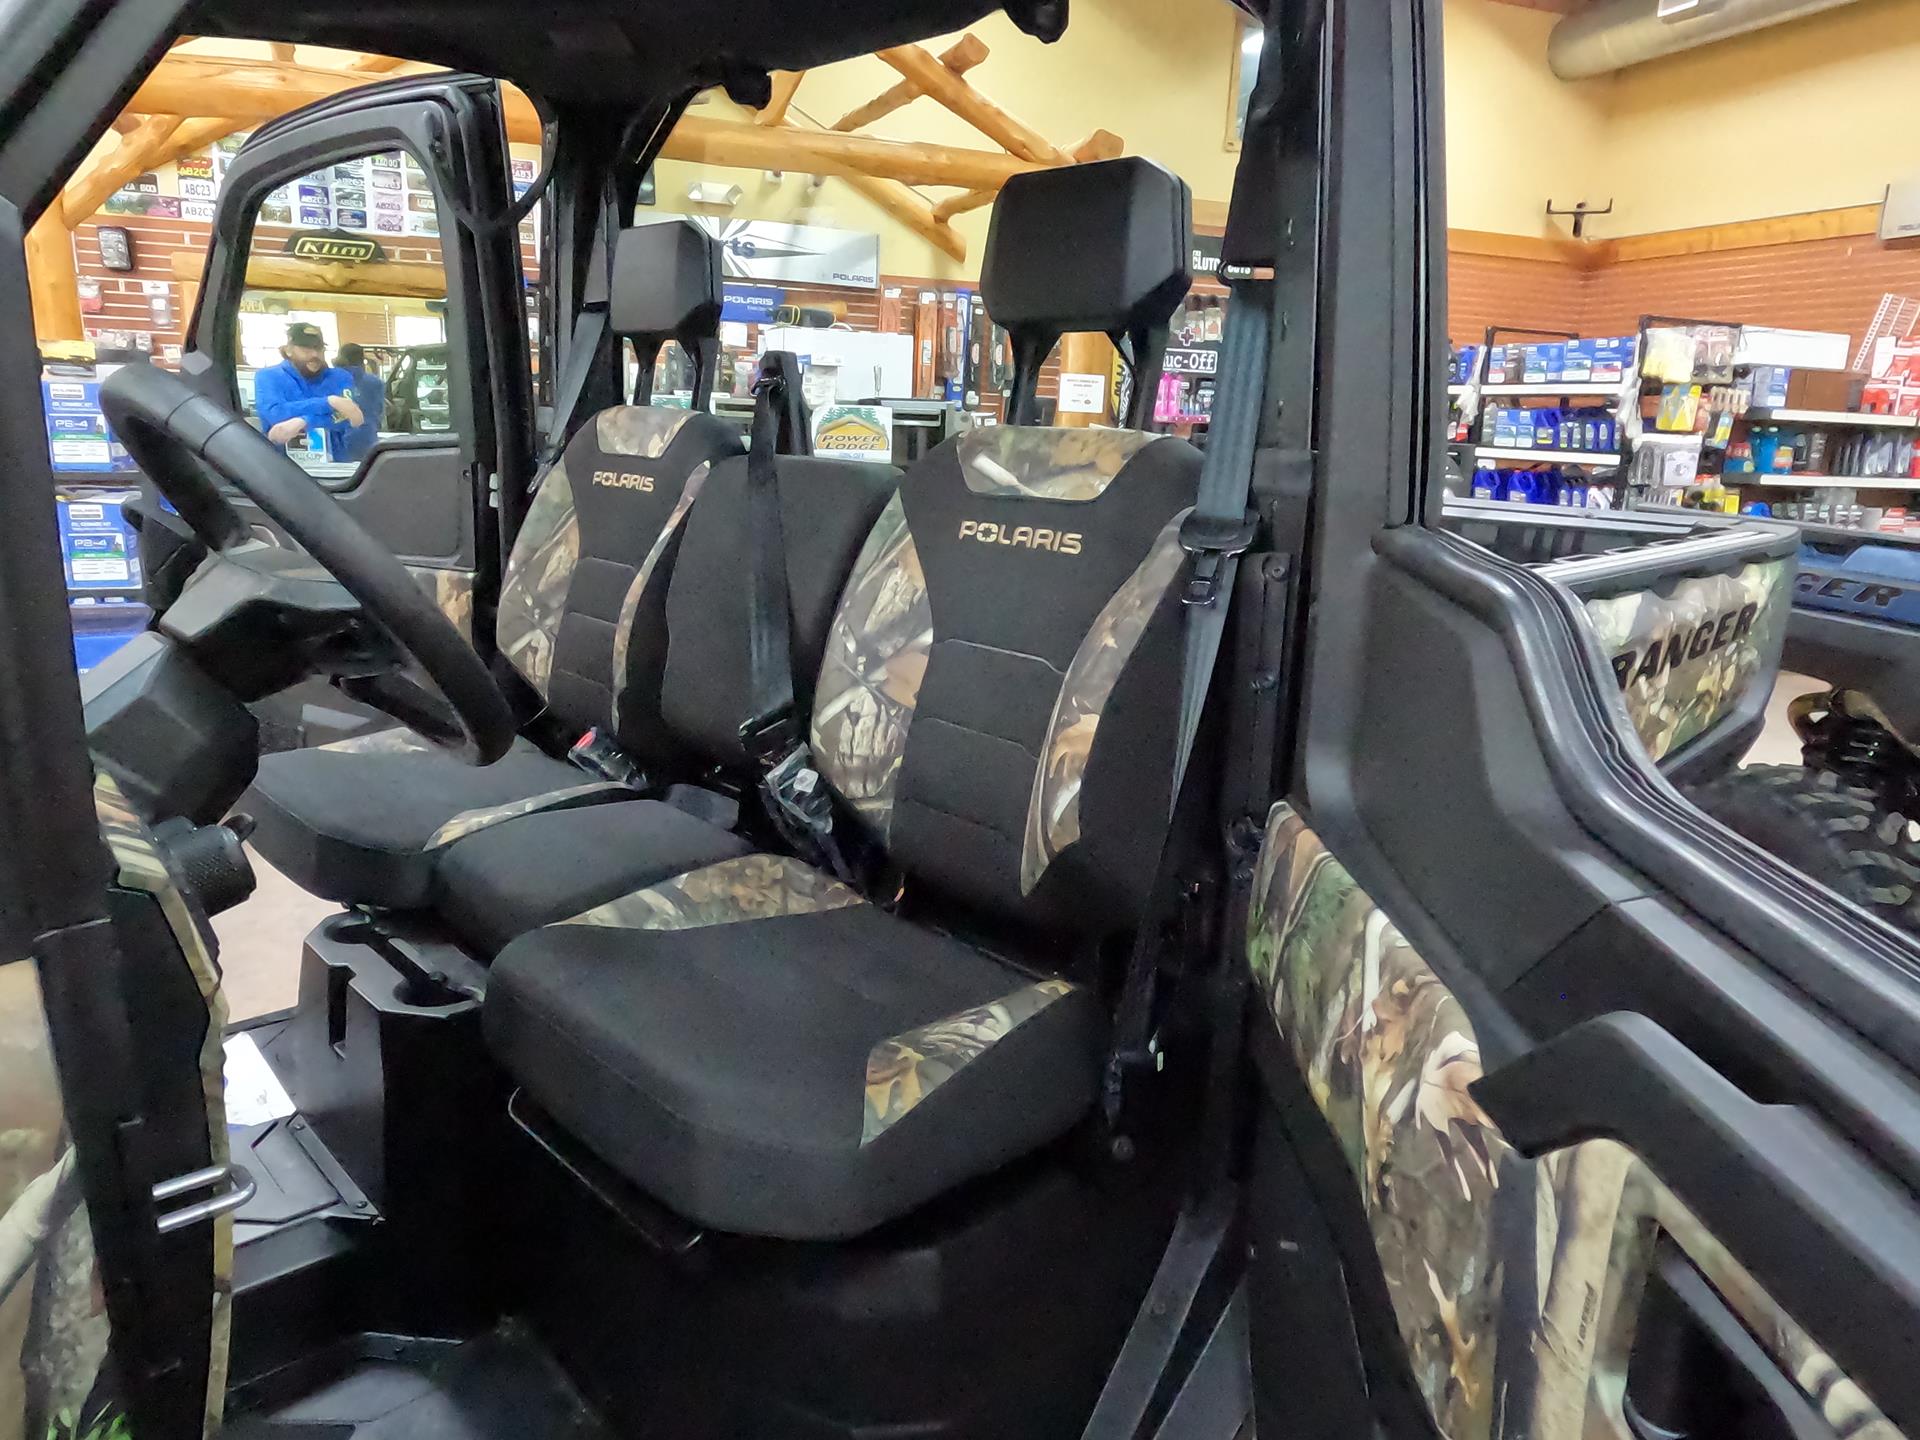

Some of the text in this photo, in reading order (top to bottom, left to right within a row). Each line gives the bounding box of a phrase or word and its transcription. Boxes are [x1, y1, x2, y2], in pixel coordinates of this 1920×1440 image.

[185, 183, 211, 197] ABC23
[302, 215, 330, 226] AB2C3
[832, 272, 875, 284] POLARIS
[723, 294, 774, 306] POLARIS
[1162, 353, 1216, 371] uc-Off
[821, 434, 881, 443] POWER
[825, 442, 880, 450] LODGE
[592, 470, 655, 493] POLARIS
[958, 520, 1083, 555] POLARIS
[1795, 571, 1904, 609] GER
[1611, 601, 1759, 691] RANGER
